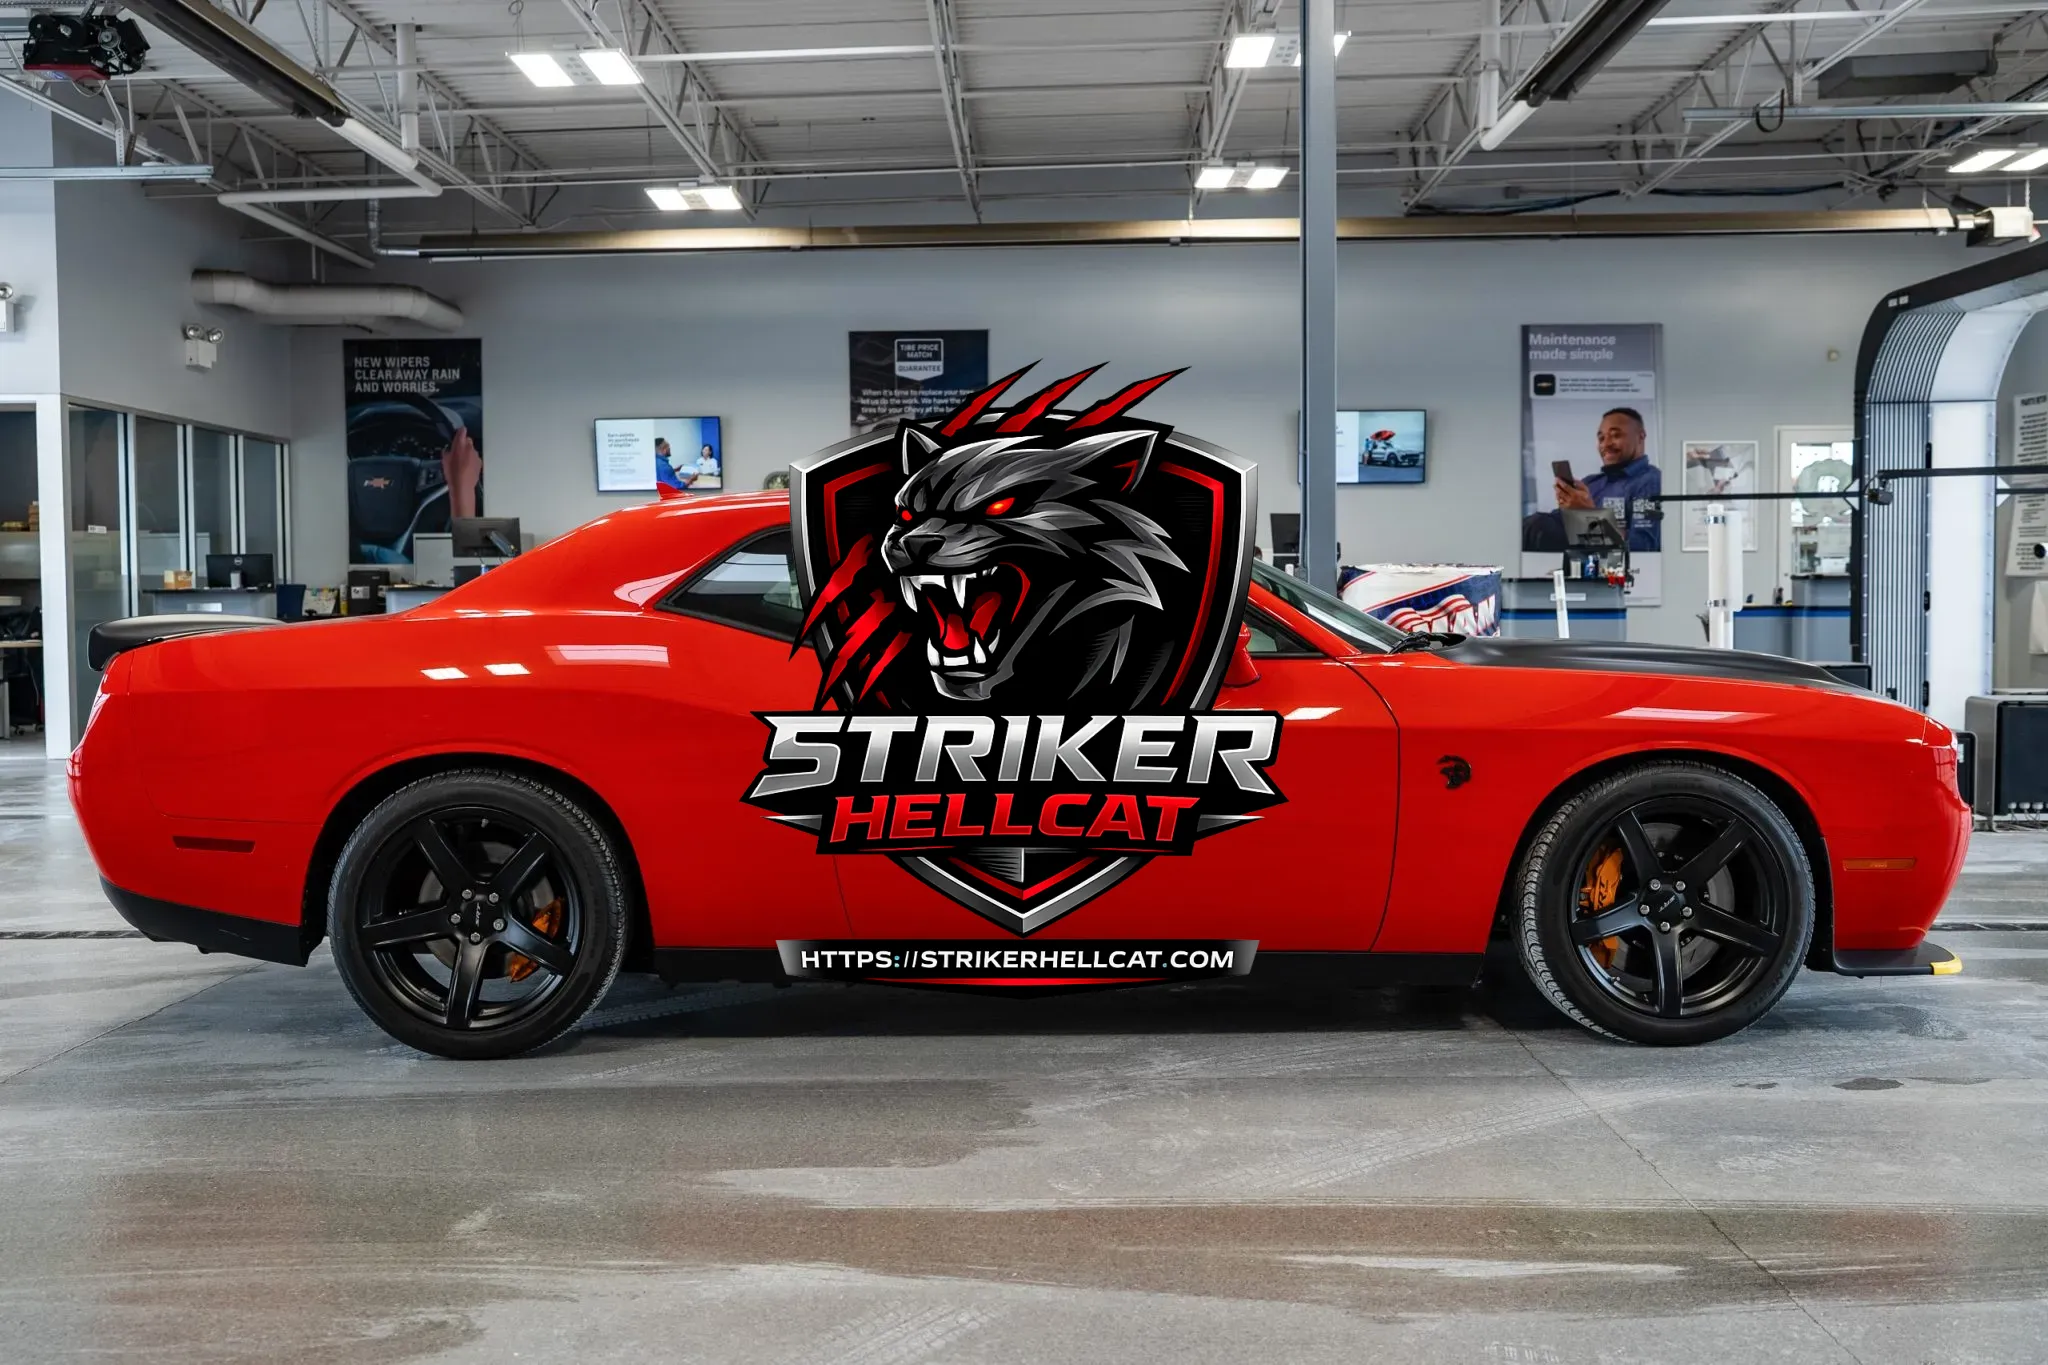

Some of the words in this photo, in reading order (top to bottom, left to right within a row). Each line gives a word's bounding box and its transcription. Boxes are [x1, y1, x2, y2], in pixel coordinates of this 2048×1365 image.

[1529, 333, 1616, 345] Maintenance
[1529, 348, 1567, 360] made
[1570, 348, 1613, 361] simple
[354, 356, 381, 368] NEW
[385, 356, 430, 368] WIPERS
[898, 364, 941, 372] GUARANTEE
[354, 369, 392, 380] CLEAR
[395, 369, 428, 380] AWAY
[432, 368, 460, 380] RAIN
[355, 382, 379, 393] AND
[382, 382, 440, 393] WORRIES.
